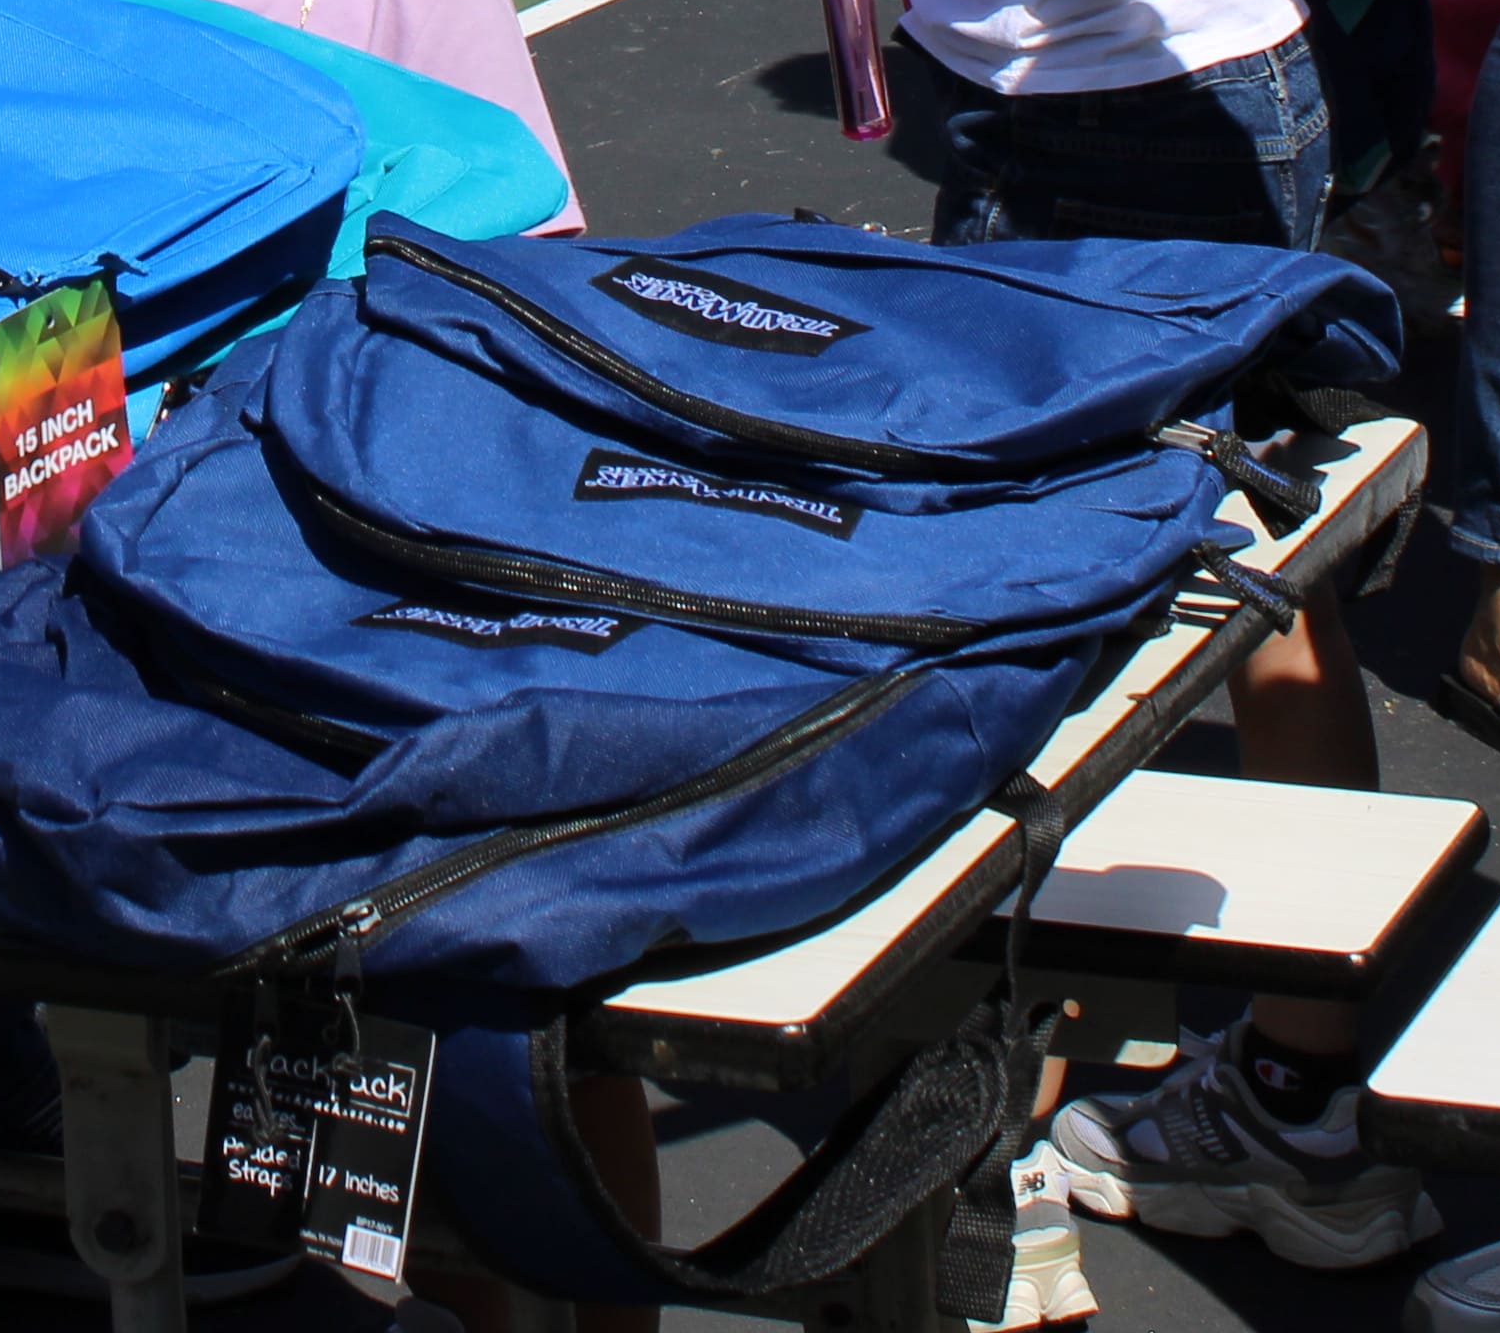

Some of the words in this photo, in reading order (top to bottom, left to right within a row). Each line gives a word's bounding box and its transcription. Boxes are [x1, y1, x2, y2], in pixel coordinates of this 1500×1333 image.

[15, 425, 38, 458] 15
[41, 398, 94, 445] INCH
[3, 422, 119, 501] BACKPACK
[318, 1164, 337, 1187] 17
[345, 1169, 400, 1203] Inches
